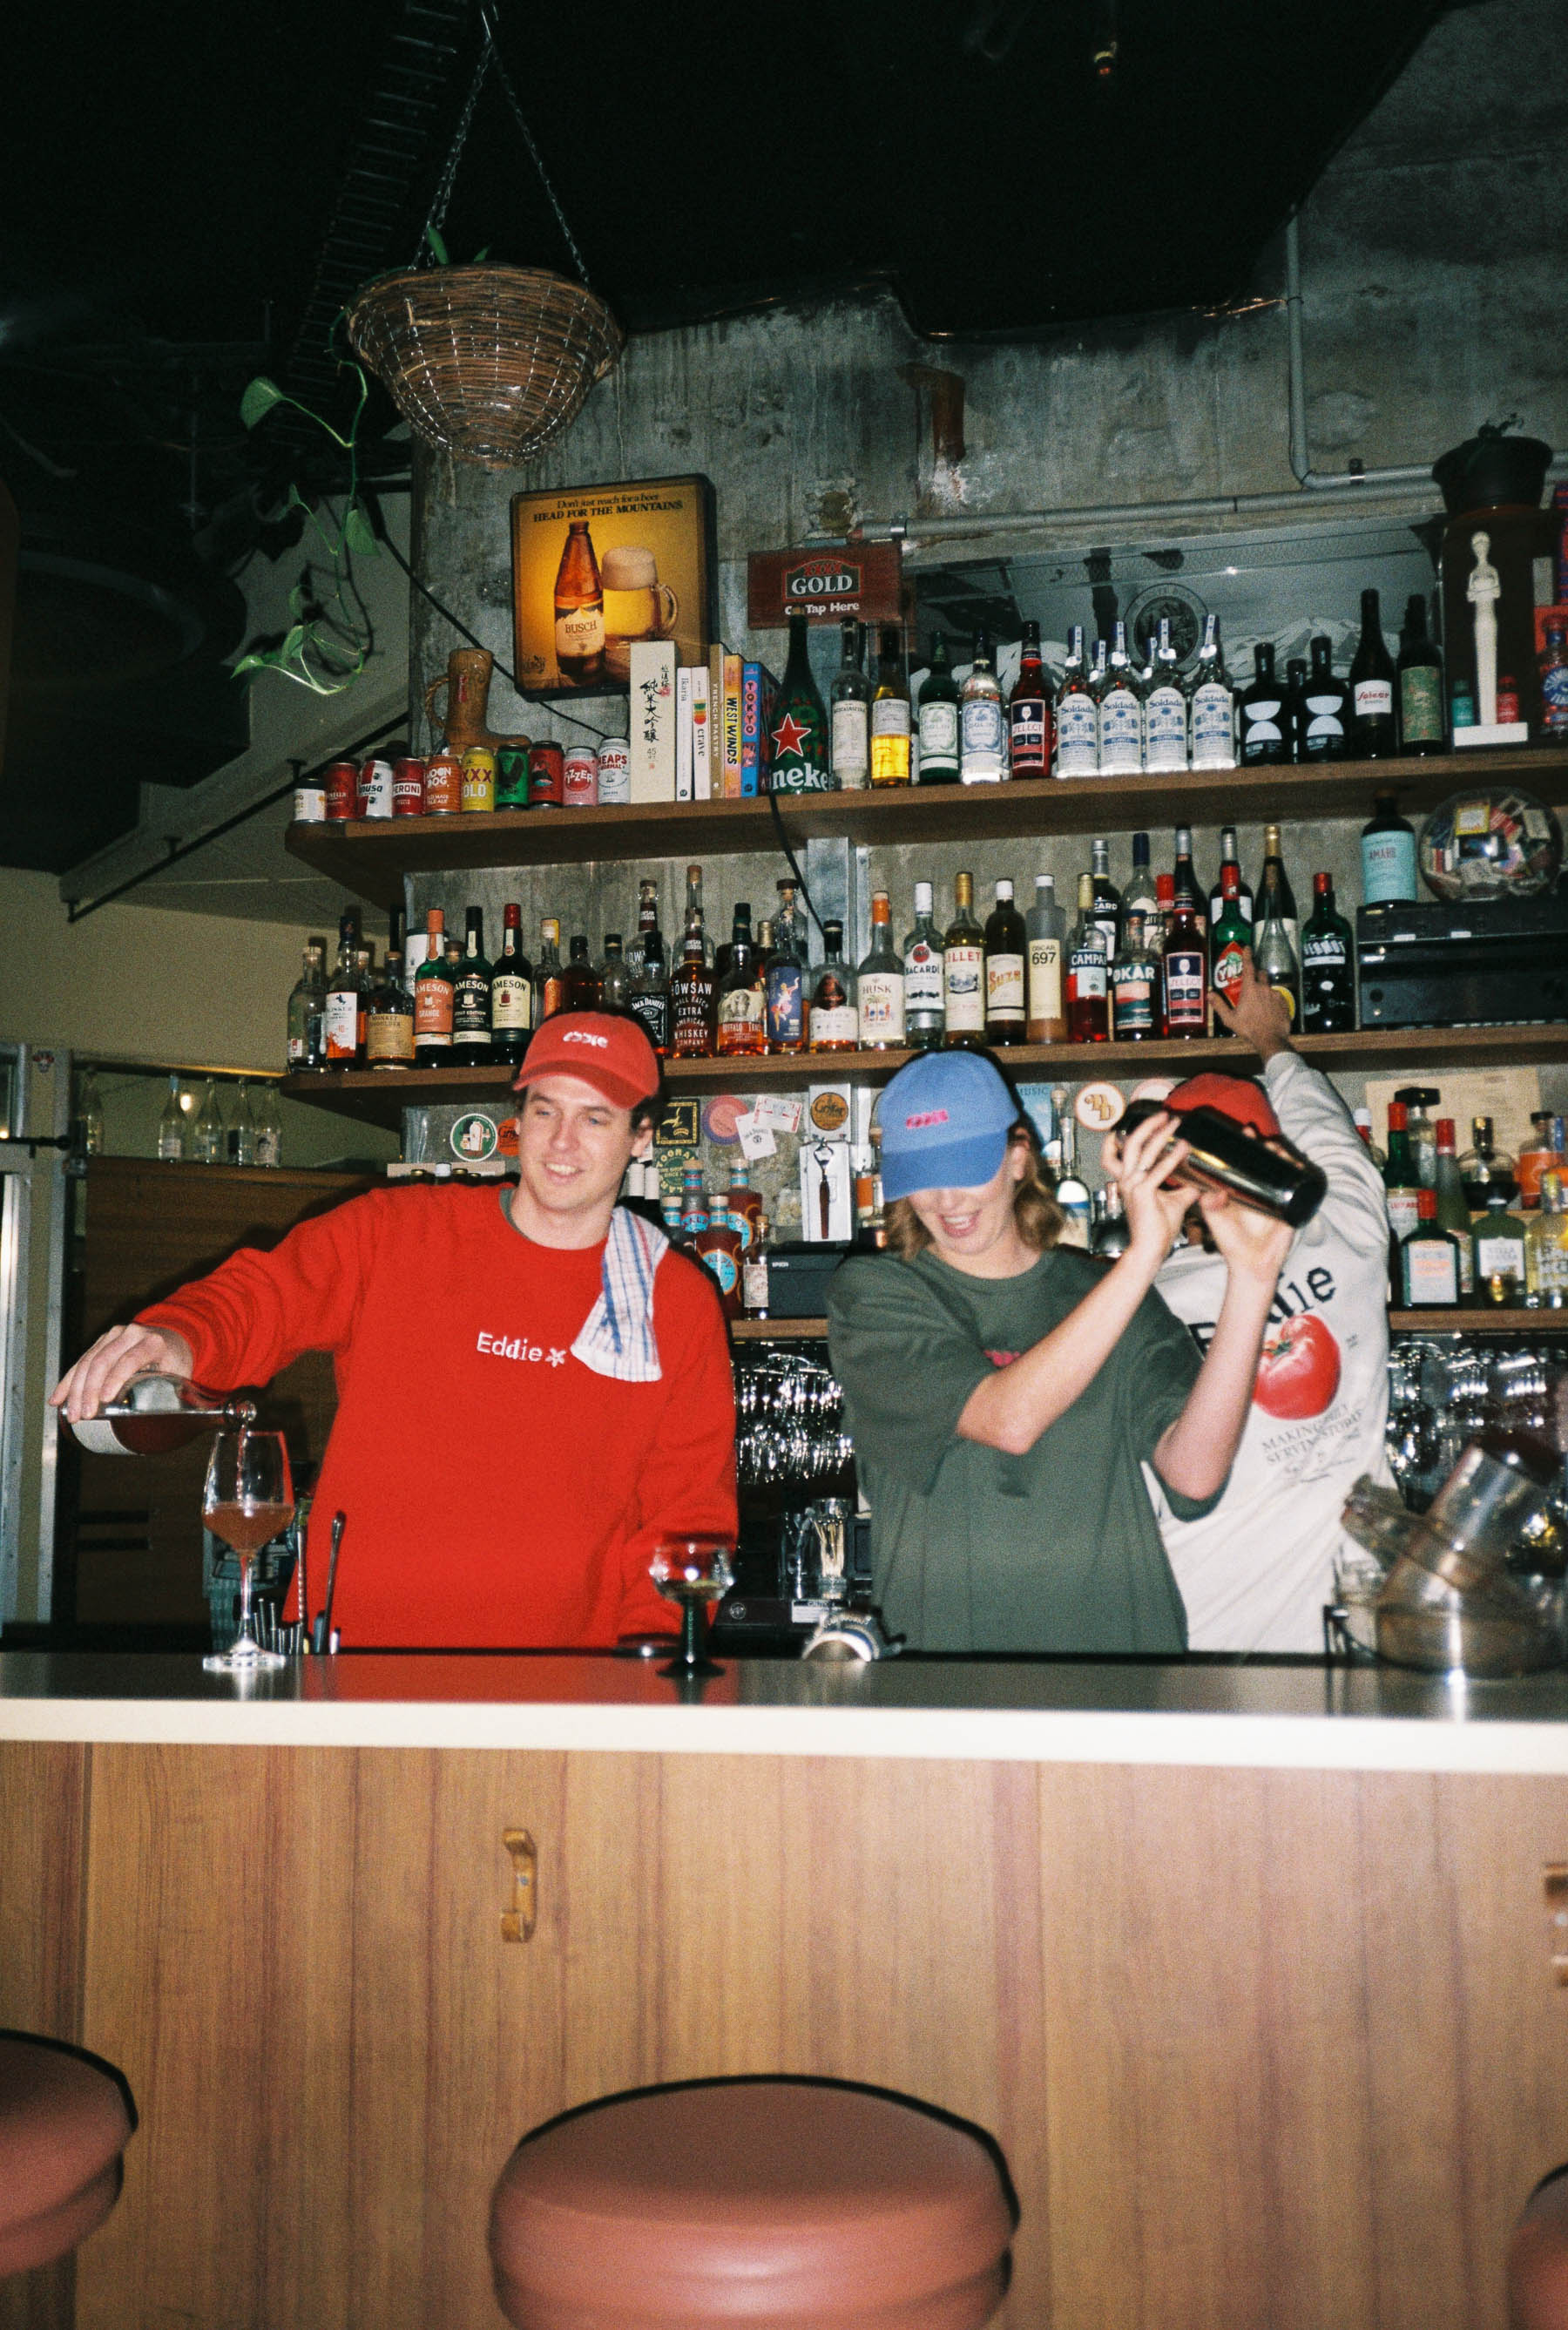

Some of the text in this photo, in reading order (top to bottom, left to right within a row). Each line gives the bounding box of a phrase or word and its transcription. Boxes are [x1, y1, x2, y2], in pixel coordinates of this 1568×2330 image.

[533, 499, 684, 523] HEAD FOR THE MOUNTAINS
[791, 574, 854, 595] GOLD
[805, 604, 827, 616] Tap
[829, 602, 861, 612] Here
[564, 620, 598, 634] BUSCH
[680, 677, 689, 701] Ikaria
[727, 697, 738, 723] WEST
[745, 681, 757, 735] TOKYO
[727, 726, 738, 766] WINDS
[773, 762, 828, 790] neke
[947, 951, 982, 963] ILLET
[1031, 952, 1057, 965] 697
[1071, 953, 1107, 965] CAMPA
[862, 985, 892, 994] HUSK
[678, 1006, 702, 1016] EXTRA
[674, 1029, 709, 1040] WHISKEY
[476, 1331, 544, 1362] Eddie
